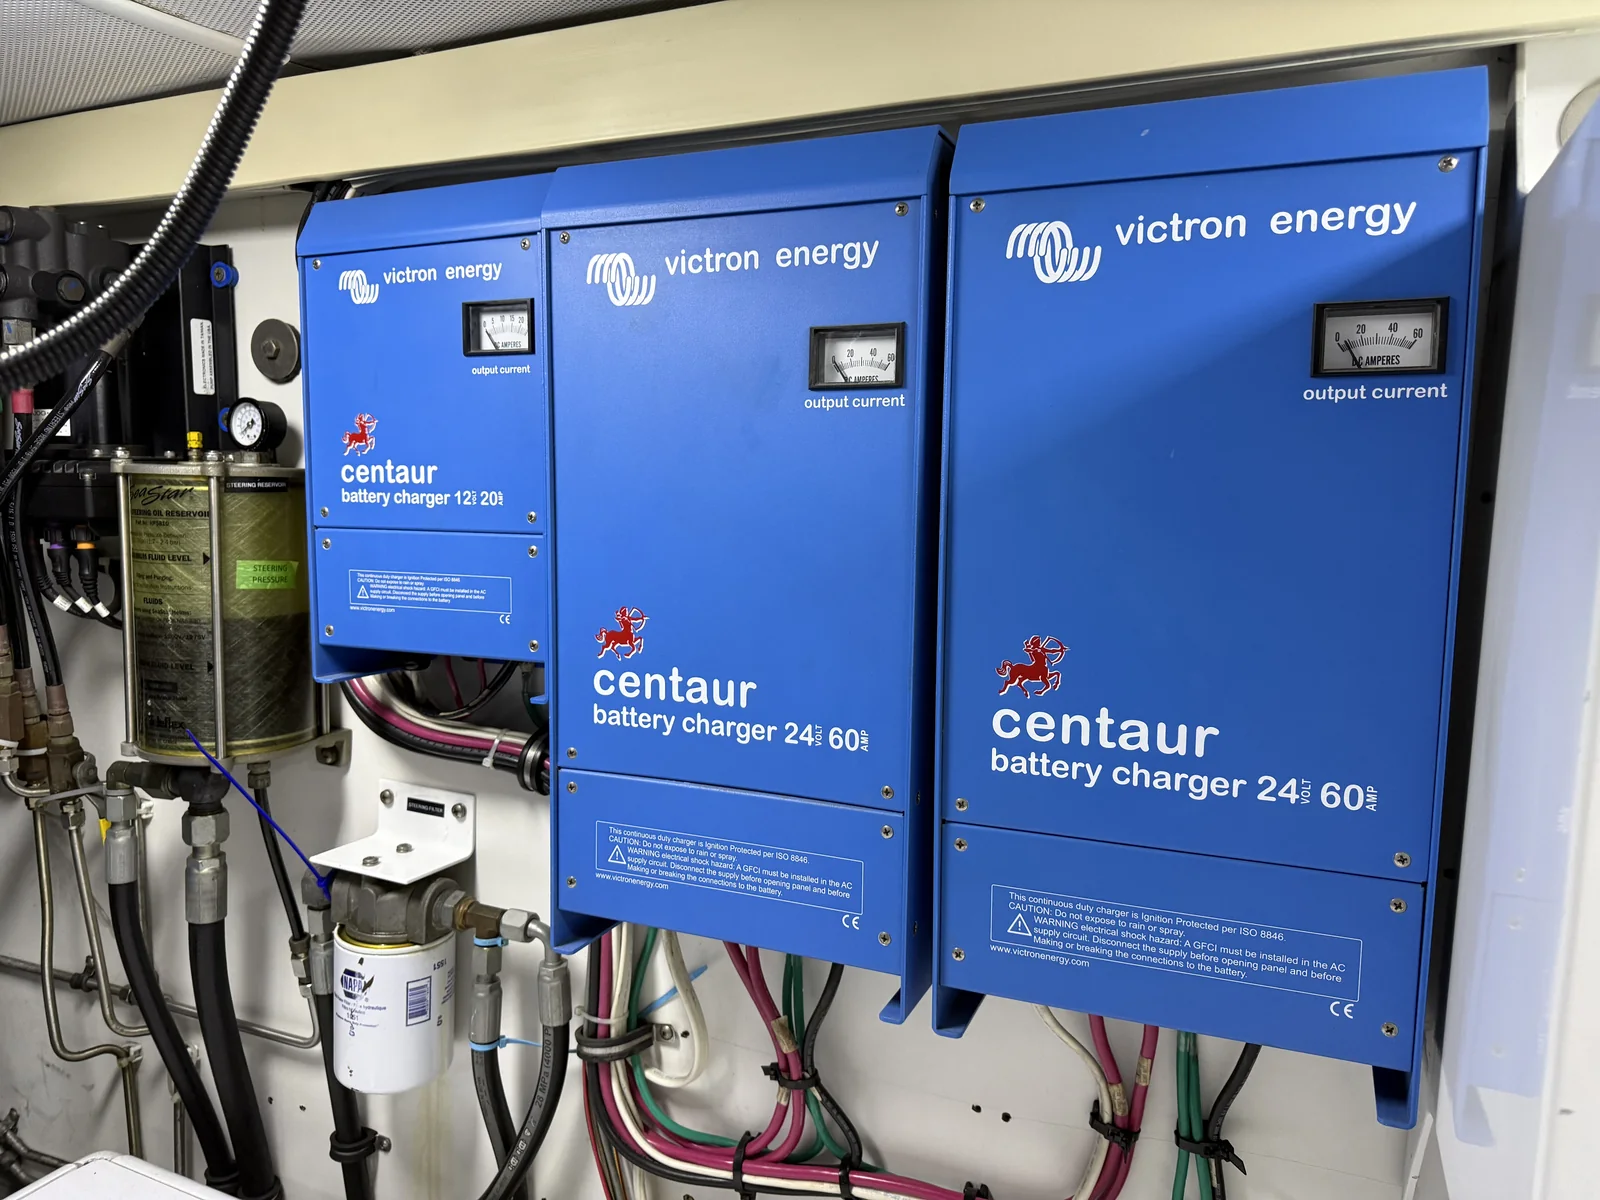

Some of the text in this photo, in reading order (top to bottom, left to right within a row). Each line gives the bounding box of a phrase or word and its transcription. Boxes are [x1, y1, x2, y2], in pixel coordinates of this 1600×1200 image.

[1115, 201, 1417, 246] victron energy
[665, 240, 879, 275] victron energy
[383, 262, 502, 284] victron energy
[500, 314, 505, 323] 10
[510, 314, 515, 322] 15
[518, 316, 525, 324] 20
[1335, 322, 1423, 342] 0 20 40 60
[832, 347, 895, 364] 0 20 40 60
[1365, 355, 1400, 366] AMPERES
[472, 364, 530, 376] output current
[854, 375, 879, 383] AMPERES
[804, 393, 905, 411] output current
[1303, 382, 1448, 403] output current
[341, 459, 438, 485] centaur
[341, 488, 391, 507] battery
[393, 489, 451, 509] charger
[454, 490, 471, 506] 12
[480, 491, 497, 506] 20
[152, 509, 164, 517] OIL
[148, 553, 166, 561] FLUID
[168, 554, 192, 562] LEVEL
[253, 564, 288, 572] STEERING
[143, 597, 163, 605] FLUIDS
[593, 666, 757, 708] centaur
[593, 703, 869, 752] battery charger 24 VOLT 60 AMP
[992, 707, 1220, 758] centaur
[990, 747, 1378, 812] battery charger 24 VOLT 60 AMP
[608, 826, 622, 834] This
[622, 829, 656, 840] continuous
[657, 834, 671, 843] duty
[672, 836, 696, 846] charger
[704, 840, 728, 850] Ignition
[729, 844, 761, 856] Protected
[775, 851, 789, 860] ISO
[642, 839, 651, 847] Do
[664, 844, 686, 853] expose
[595, 872, 668, 889] www.victronenergy.com
[1008, 891, 1026, 901] This
[1028, 896, 1073, 908] continuous
[1075, 902, 1093, 913] duty
[1095, 906, 1129, 917] charger
[1131, 910, 1138, 919] is
[1141, 912, 1173, 924] Ignition
[1175, 917, 1218, 931] Protected
[1221, 925, 1236, 933] per
[1239, 926, 1257, 936] ISO
[1054, 908, 1066, 917] Do
[1069, 912, 1082, 920] not
[1084, 915, 1115, 925] expose
[1118, 919, 1126, 927] to
[1128, 921, 1145, 930] rain
[1033, 915, 1078, 929] WARNING
[1080, 924, 1118, 936] electrical
[1120, 930, 1146, 940] shock
[1183, 939, 1191, 947] A
[1192, 940, 1217, 951] GFCI
[1220, 946, 1242, 956] must
[1245, 948, 1256, 958] be
[1259, 953, 1298, 964] installed
[1301, 957, 1309, 966] in
[1312, 960, 1327, 969] the
[1329, 962, 1345, 972] AC
[1033, 935, 1063, 949] Making
[1076, 942, 1112, 957] breaking
[1115, 949, 1128, 958] the
[1130, 953, 1183, 967] connections
[1186, 960, 1195, 969] to
[1197, 962, 1211, 972] the
[433, 958, 447, 971] 1551
[989, 944, 1089, 967] www.victronenergy.com
[1033, 927, 1060, 938] supply
[1092, 934, 1140, 950] Disconnect
[1142, 943, 1156, 952] the
[1158, 947, 1187, 959] supply
[1190, 950, 1218, 962] before
[1221, 957, 1258, 970] opening
[1260, 963, 1287, 973] panel
[1289, 968, 1307, 976] and
[1310, 970, 1341, 982] before
[534, 1039, 553, 1108] 28 MPa (4000
